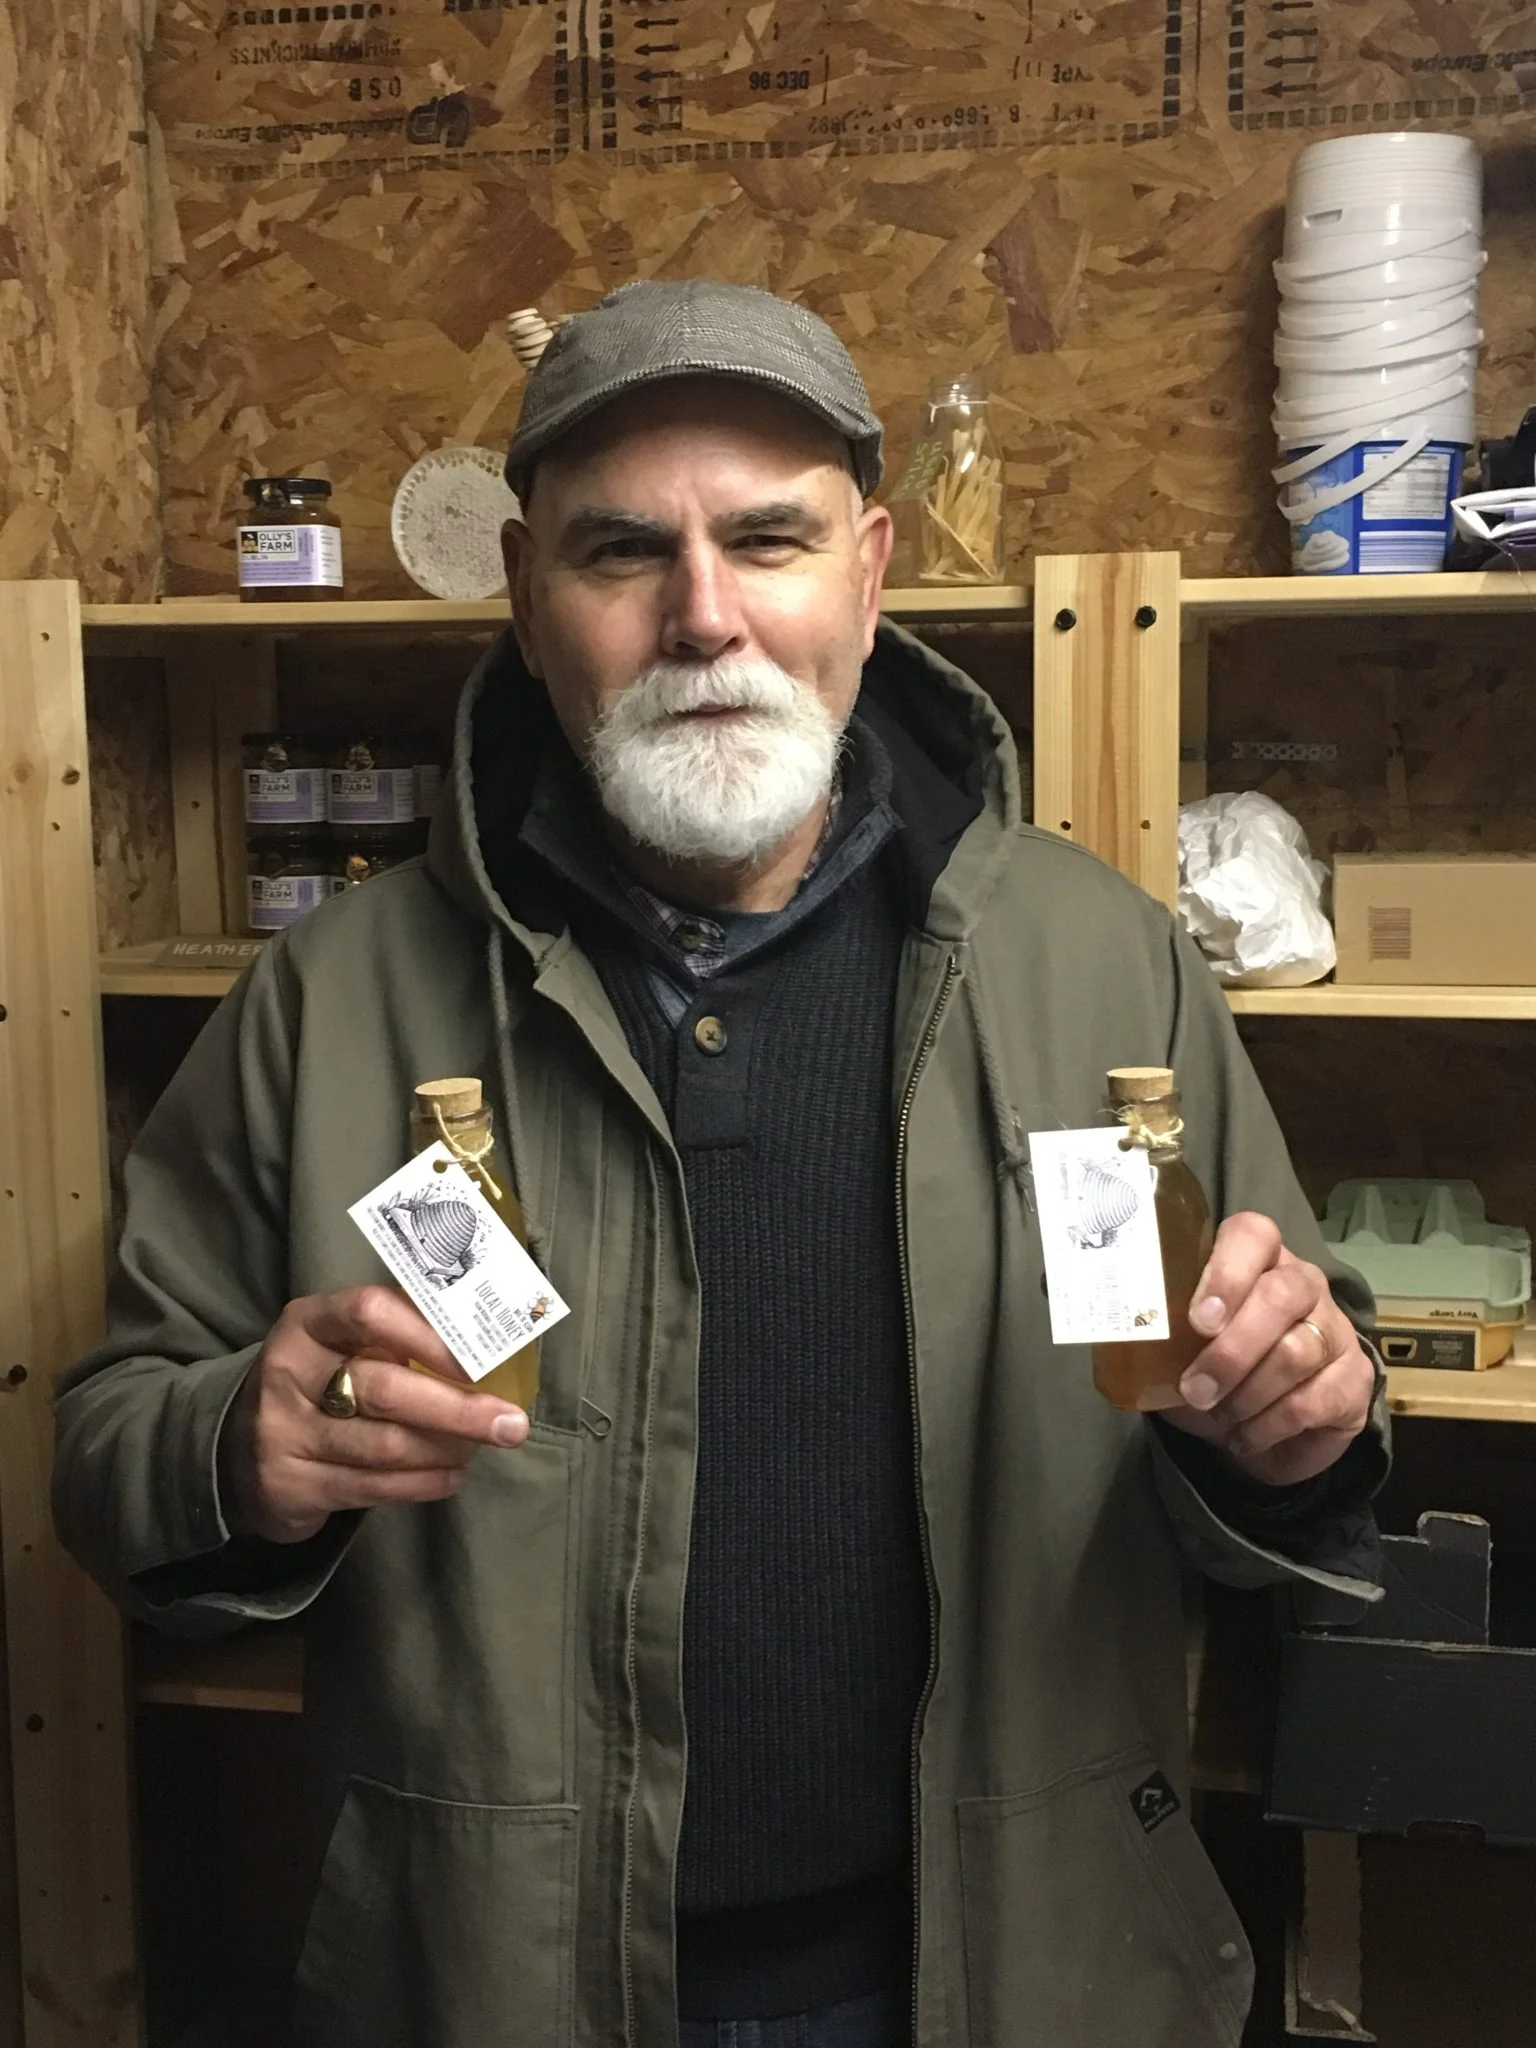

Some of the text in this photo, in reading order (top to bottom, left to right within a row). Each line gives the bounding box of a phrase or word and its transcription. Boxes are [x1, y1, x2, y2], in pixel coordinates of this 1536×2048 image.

[776, 70, 810, 90] DEC
[259, 532, 292, 541] OLLY'S
[260, 542, 293, 551] FARM
[261, 784, 290, 792] FARM
[343, 784, 372, 792] FARM
[263, 890, 292, 898] FARM
[475, 1279, 503, 1313] LOCAL
[495, 1307, 526, 1342] HONEY
